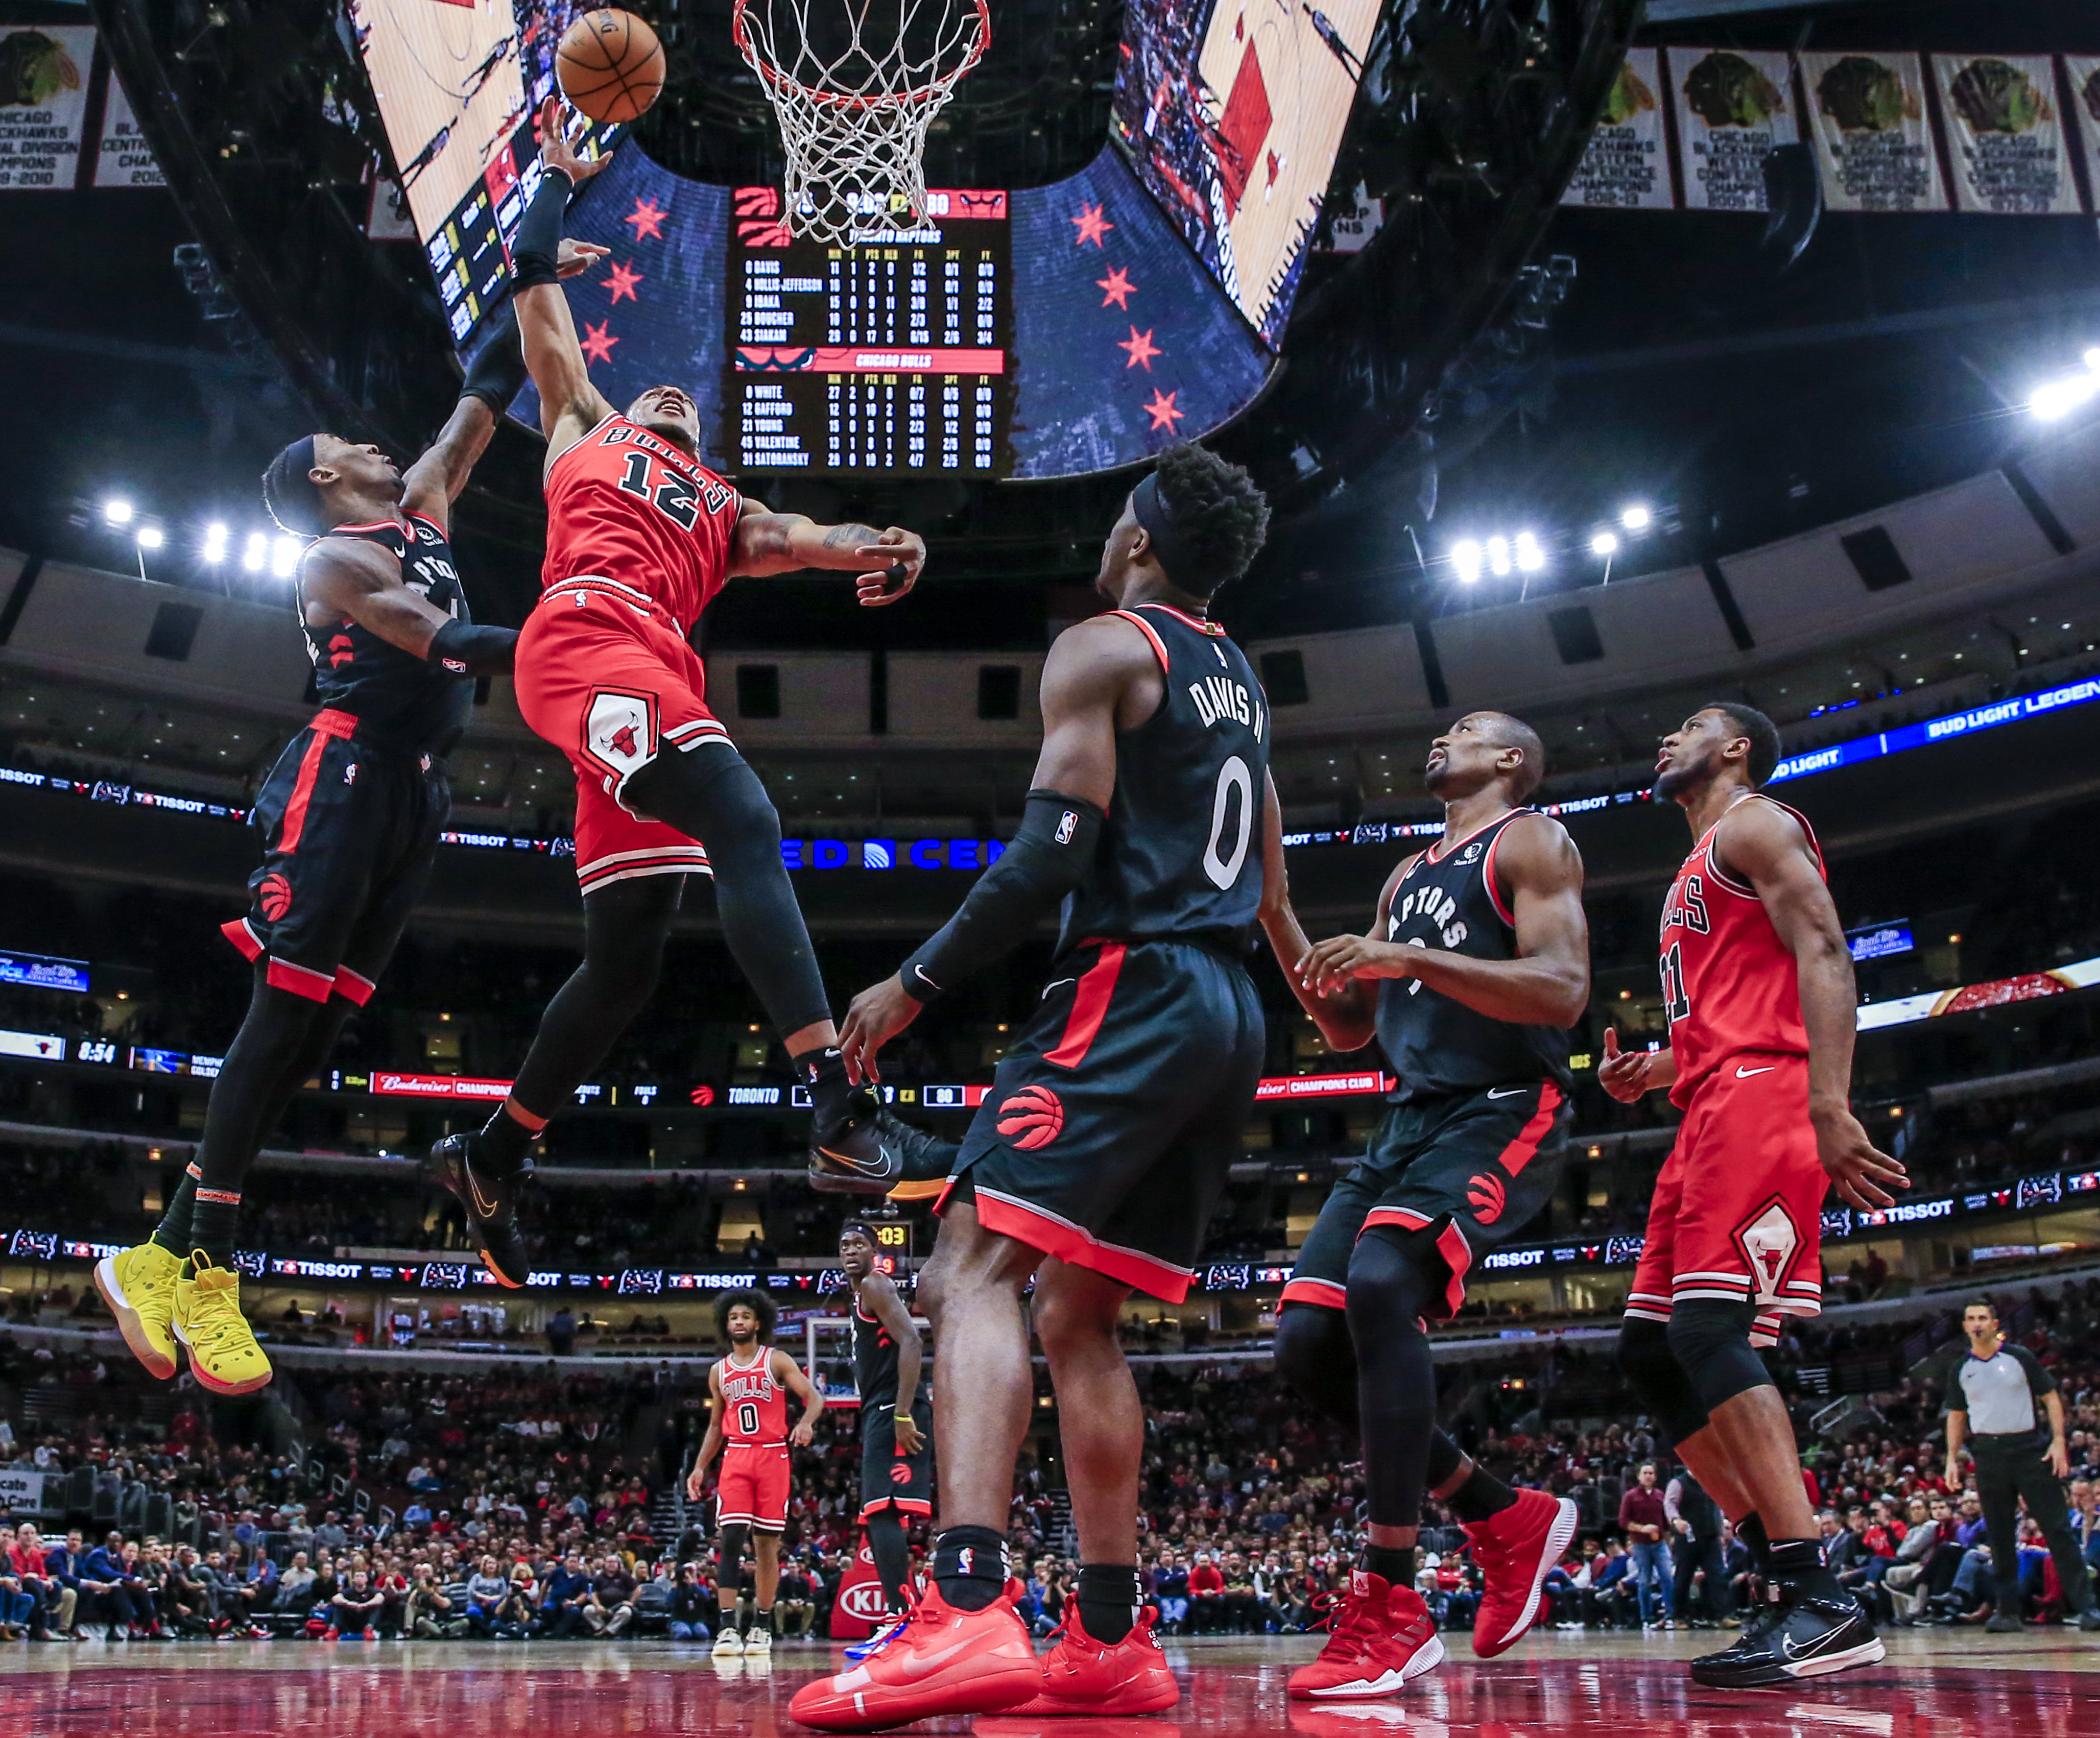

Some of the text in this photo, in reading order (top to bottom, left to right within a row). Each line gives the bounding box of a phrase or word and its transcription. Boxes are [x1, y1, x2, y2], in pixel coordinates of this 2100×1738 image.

[21, 141, 78, 154] DIVISION
[926, 194, 949, 215] 80
[830, 261, 840, 275] 11
[868, 261, 875, 275] 2
[745, 278, 752, 291] 4
[888, 279, 893, 293] 1
[829, 295, 840, 309] 15
[886, 296, 895, 309] 11
[740, 311, 753, 325] 25
[850, 312, 856, 326] 1
[886, 312, 894, 327] 4
[739, 328, 753, 342] 43
[866, 329, 877, 343] 17
[828, 385, 840, 399] 27
[849, 385, 856, 400] 2
[742, 402, 753, 416] 12
[829, 402, 840, 416] 12
[886, 403, 893, 417] 2
[742, 419, 753, 432] 21
[740, 436, 753, 449] 45
[850, 437, 855, 450] 1
[886, 437, 892, 450] 1
[742, 452, 753, 466] 31
[885, 453, 893, 467] 2
[598, 426, 733, 515] BULLS
[617, 451, 700, 534] 12
[1188, 676, 1250, 728] DAVIS
[1929, 717, 1966, 738] BUD
[1967, 701, 2021, 730] LIGHT
[1791, 749, 1840, 775] LIGHT
[0, 769, 45, 786] ISSOT
[155, 795, 205, 813] TISSOT
[1559, 795, 1610, 814] TISSOT
[1203, 755, 1253, 891] 0
[458, 833, 508, 848] TISSOT
[78, 1041, 116, 1064] 8:54
[380, 1075, 451, 1092] Budweiser
[1290, 1078, 1347, 1093] CHAMPIONS
[1348, 1076, 1374, 1089] CLUB
[728, 1088, 954, 1104] TORONTO 80
[1886, 1199, 1954, 1222] TISSOT
[298, 1262, 362, 1278] TISSOT
[693, 1274, 757, 1289] TISSOT
[722, 1375, 773, 1409] BULLS
[737, 1403, 760, 1435] 0
